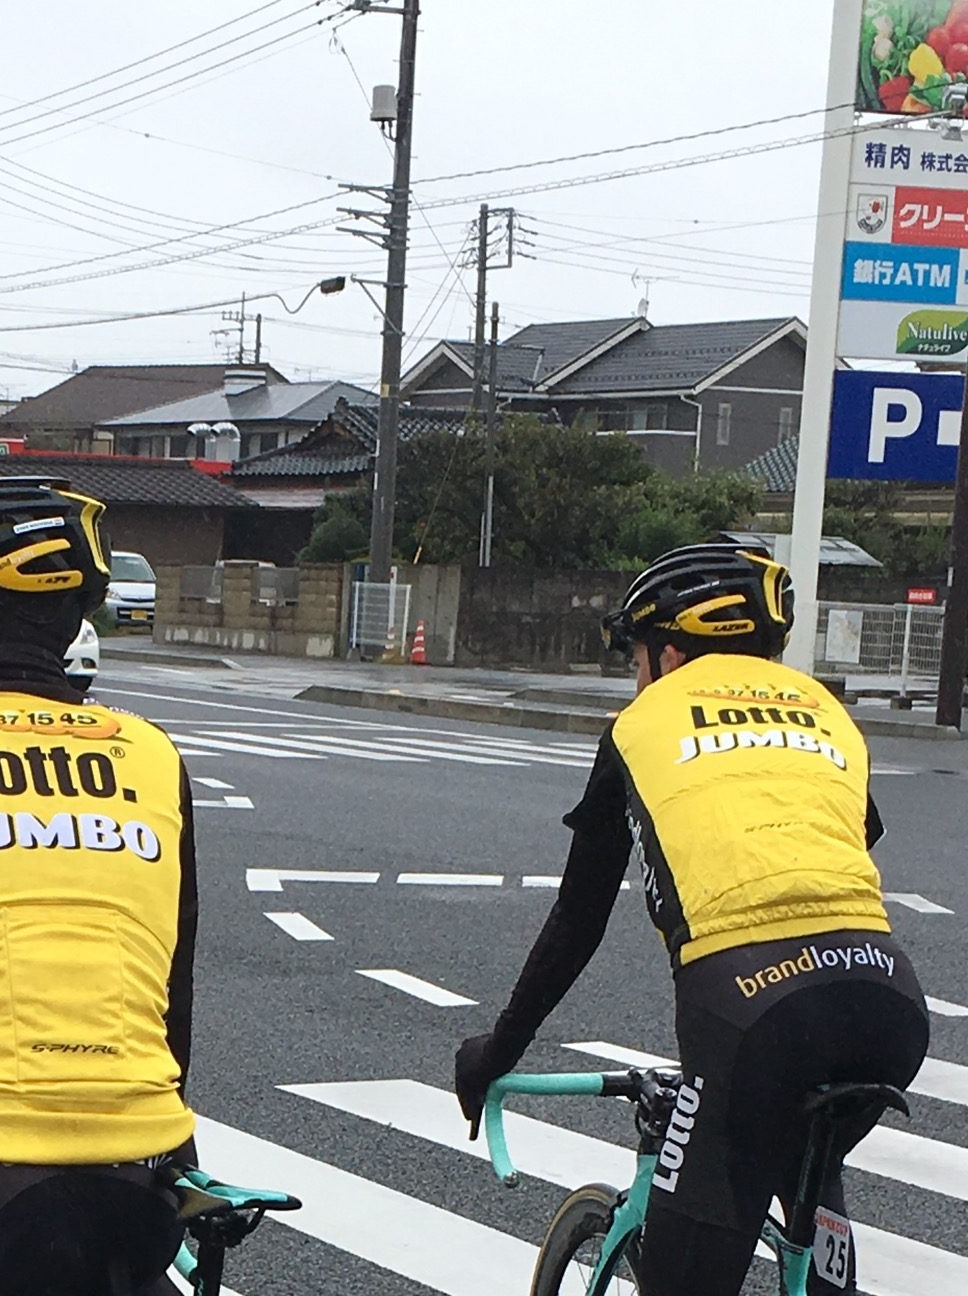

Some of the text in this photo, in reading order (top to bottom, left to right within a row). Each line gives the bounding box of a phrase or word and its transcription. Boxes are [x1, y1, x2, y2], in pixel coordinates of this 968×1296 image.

[865, 142, 911, 170] 精肉
[899, 203, 968, 232] クリー
[853, 258, 951, 288] 銀行ATM
[907, 321, 968, 342] Natulive
[868, 387, 923, 463] P
[27, 713, 54, 725] 15
[60, 713, 98, 725] 45
[690, 704, 832, 735] Lotto.
[675, 730, 847, 771] JUMBO
[735, 942, 895, 999] brandloyalty
[825, 1234, 846, 1279] 25
